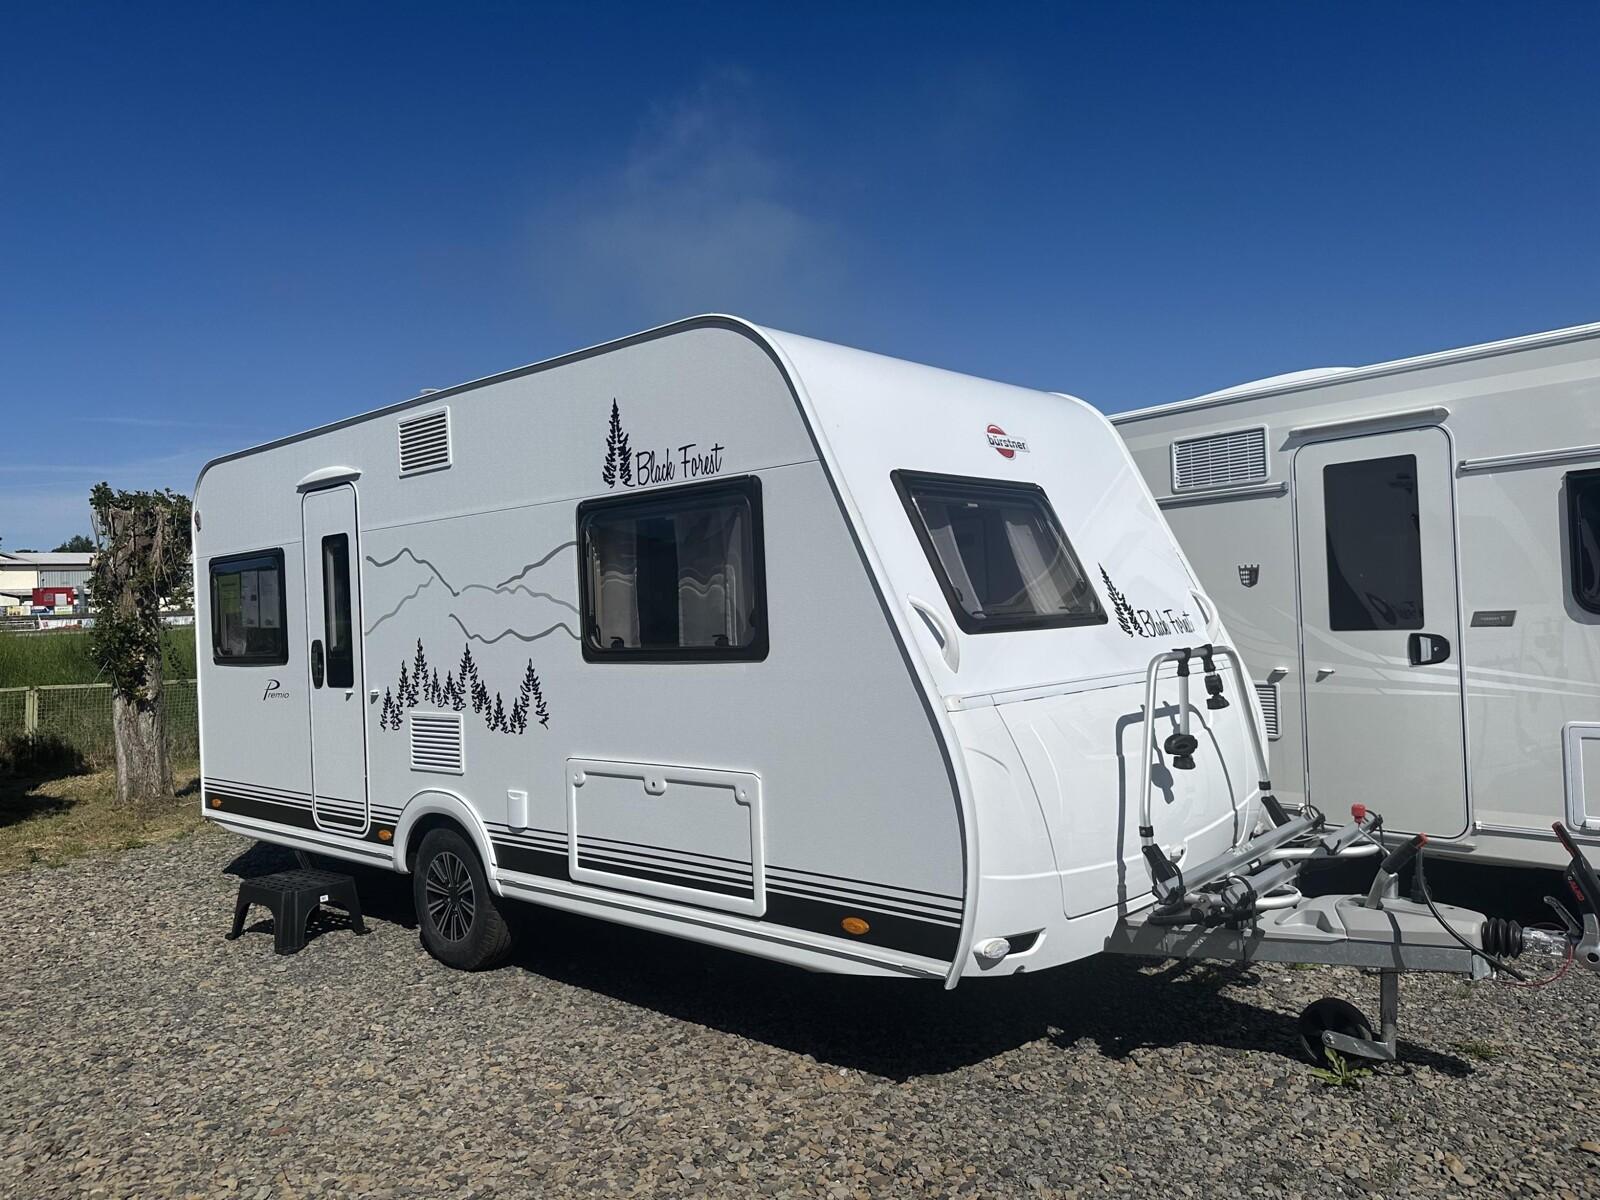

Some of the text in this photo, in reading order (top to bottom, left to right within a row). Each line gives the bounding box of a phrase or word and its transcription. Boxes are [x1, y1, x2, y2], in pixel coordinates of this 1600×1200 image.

[986, 433, 1026, 449] bürstner
[636, 443, 725, 485] Black Forest
[263, 679, 289, 701] Premio
